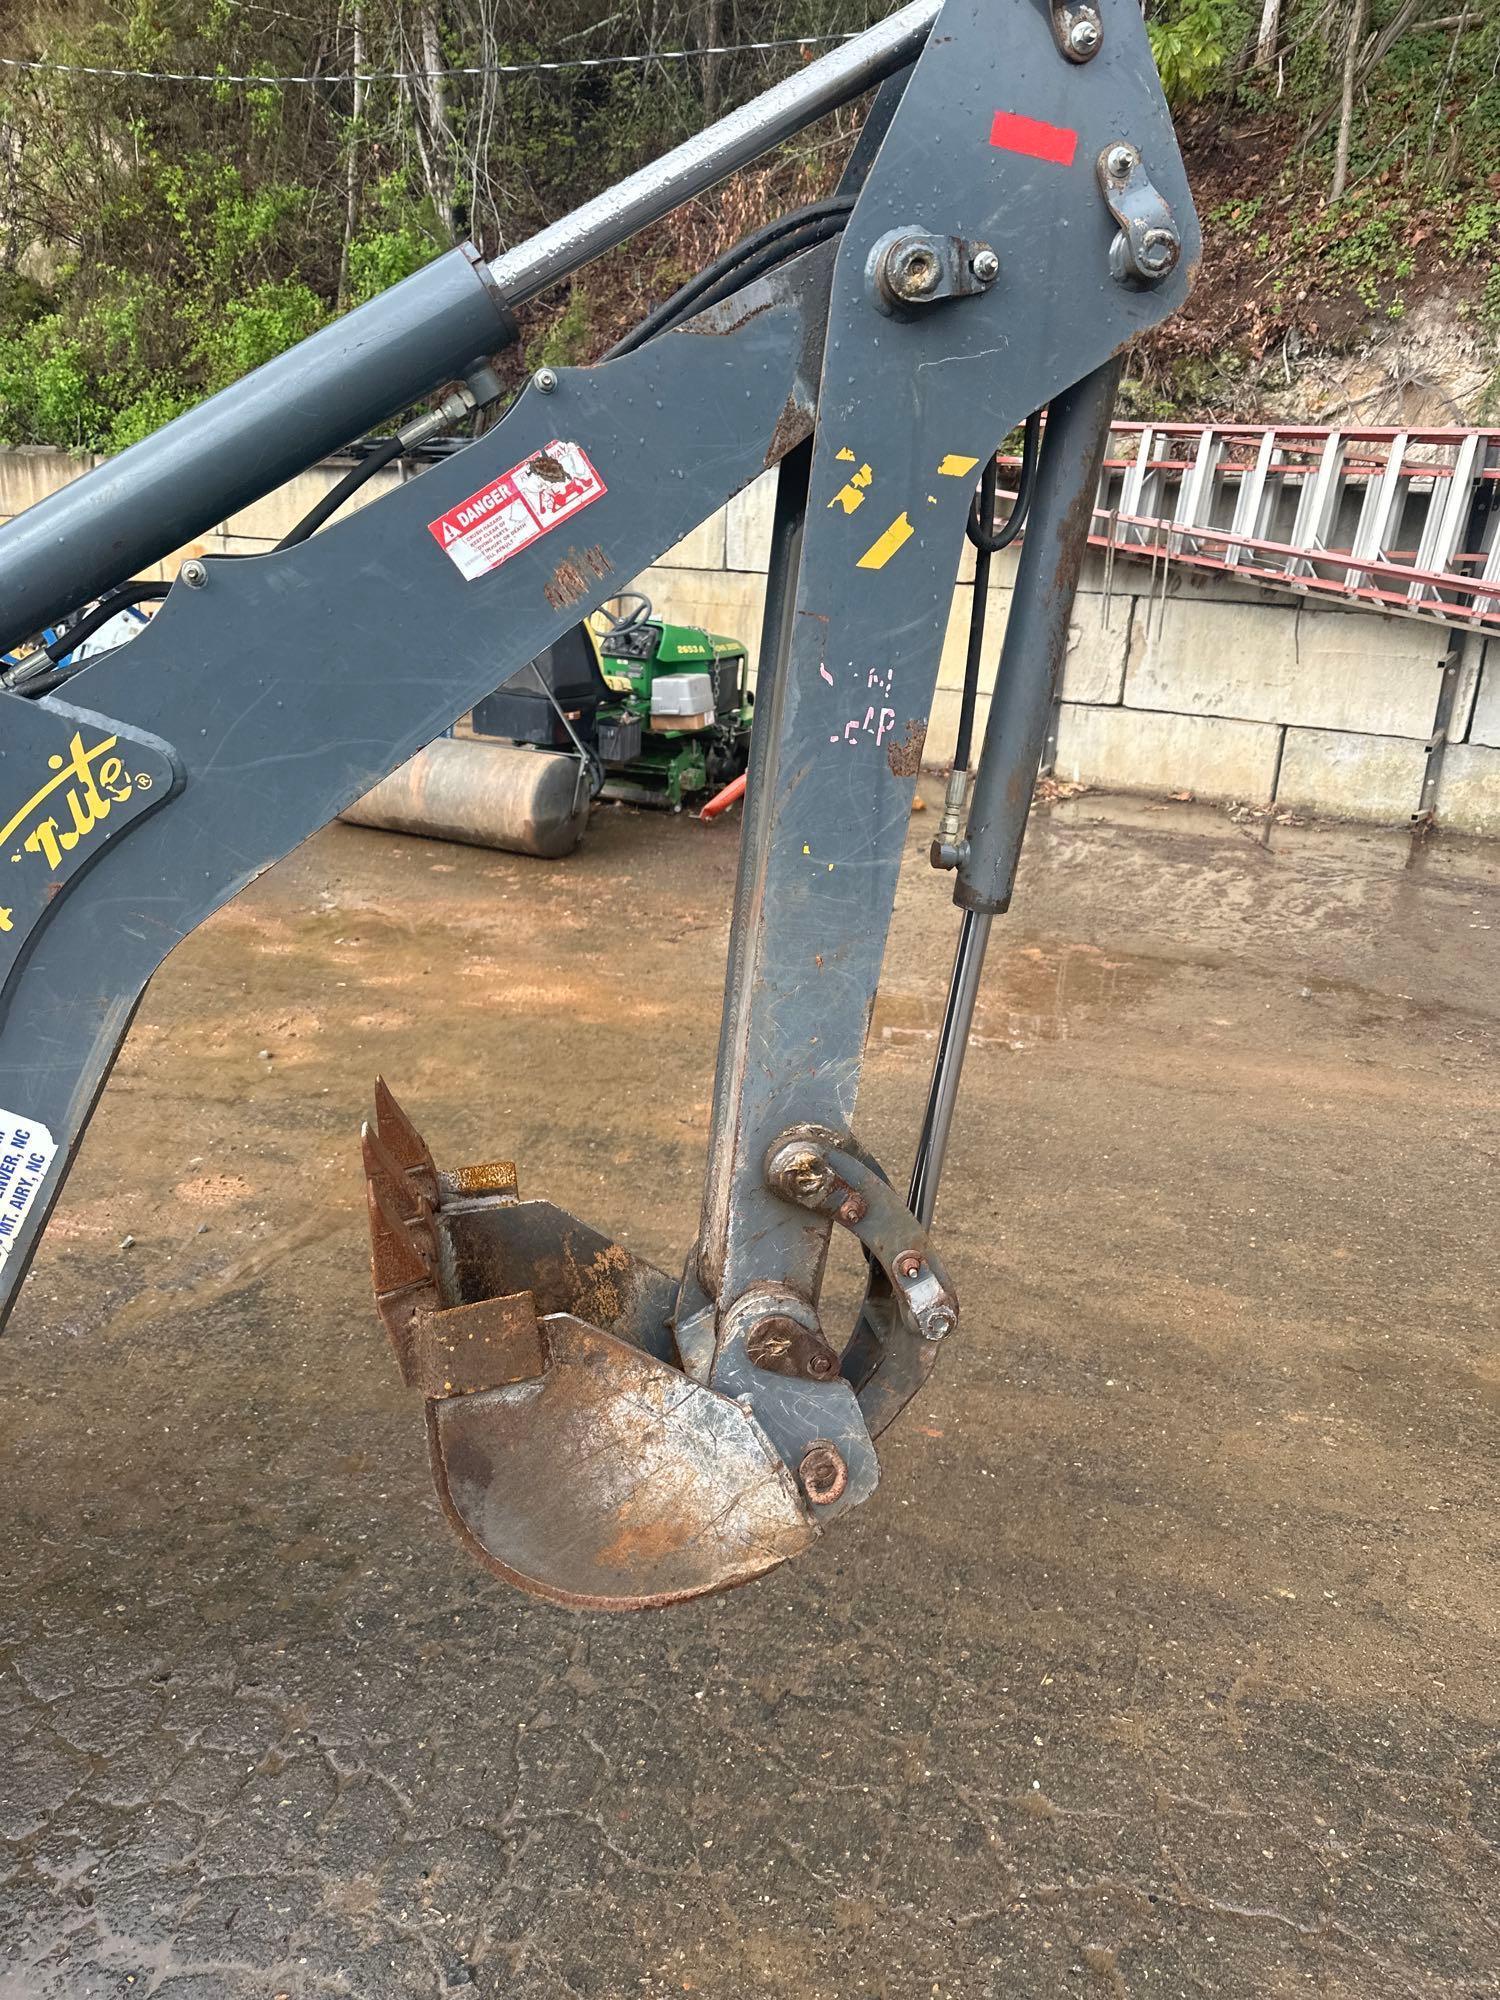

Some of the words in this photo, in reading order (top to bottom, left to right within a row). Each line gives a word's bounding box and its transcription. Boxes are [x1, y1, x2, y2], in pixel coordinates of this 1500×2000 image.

[456, 484, 514, 527] DANGER
[467, 528, 483, 542] CRUSH
[482, 515, 503, 531] HAZARD
[470, 537, 483, 548] KEEP
[483, 525, 499, 539] CLEAR
[485, 540, 503, 553] INJURY
[510, 523, 527, 536] DEATH
[10, 1128, 31, 1149] NC
[25, 1152, 46, 1173] NC
[9, 1176, 39, 1211] AIRY,
[0, 1213, 20, 1237] MT.
